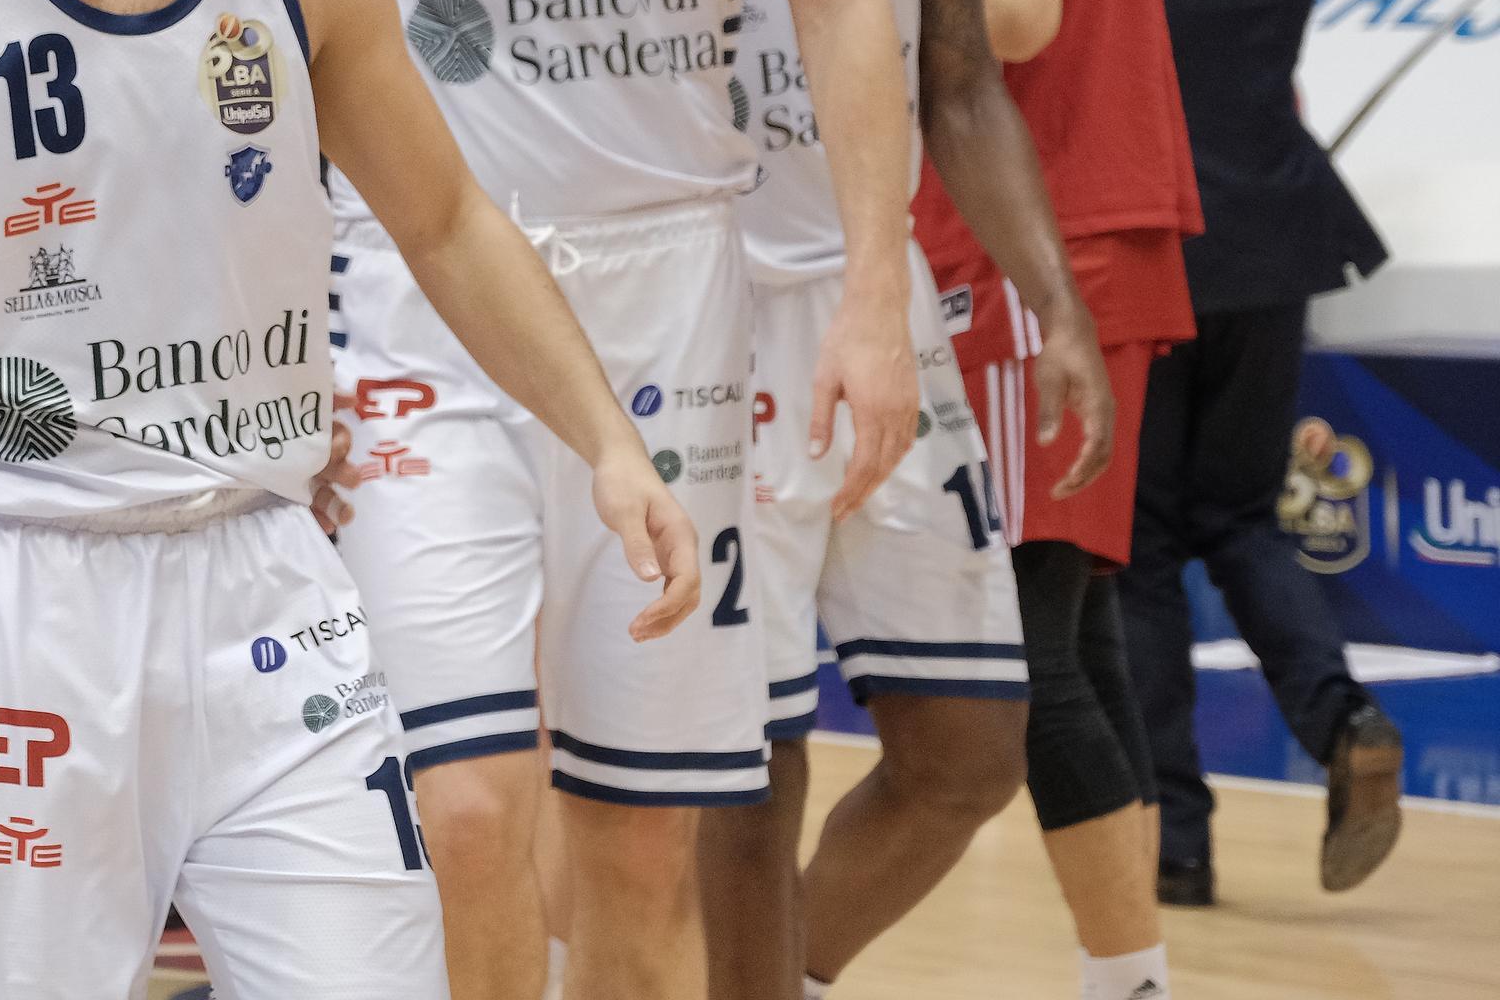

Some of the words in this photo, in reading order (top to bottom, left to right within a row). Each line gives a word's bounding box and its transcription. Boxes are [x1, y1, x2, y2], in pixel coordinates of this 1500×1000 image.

[87, 329, 251, 402] Banco
[263, 309, 309, 368] di
[710, 526, 750, 627] 2
[365, 756, 434, 871] 1
